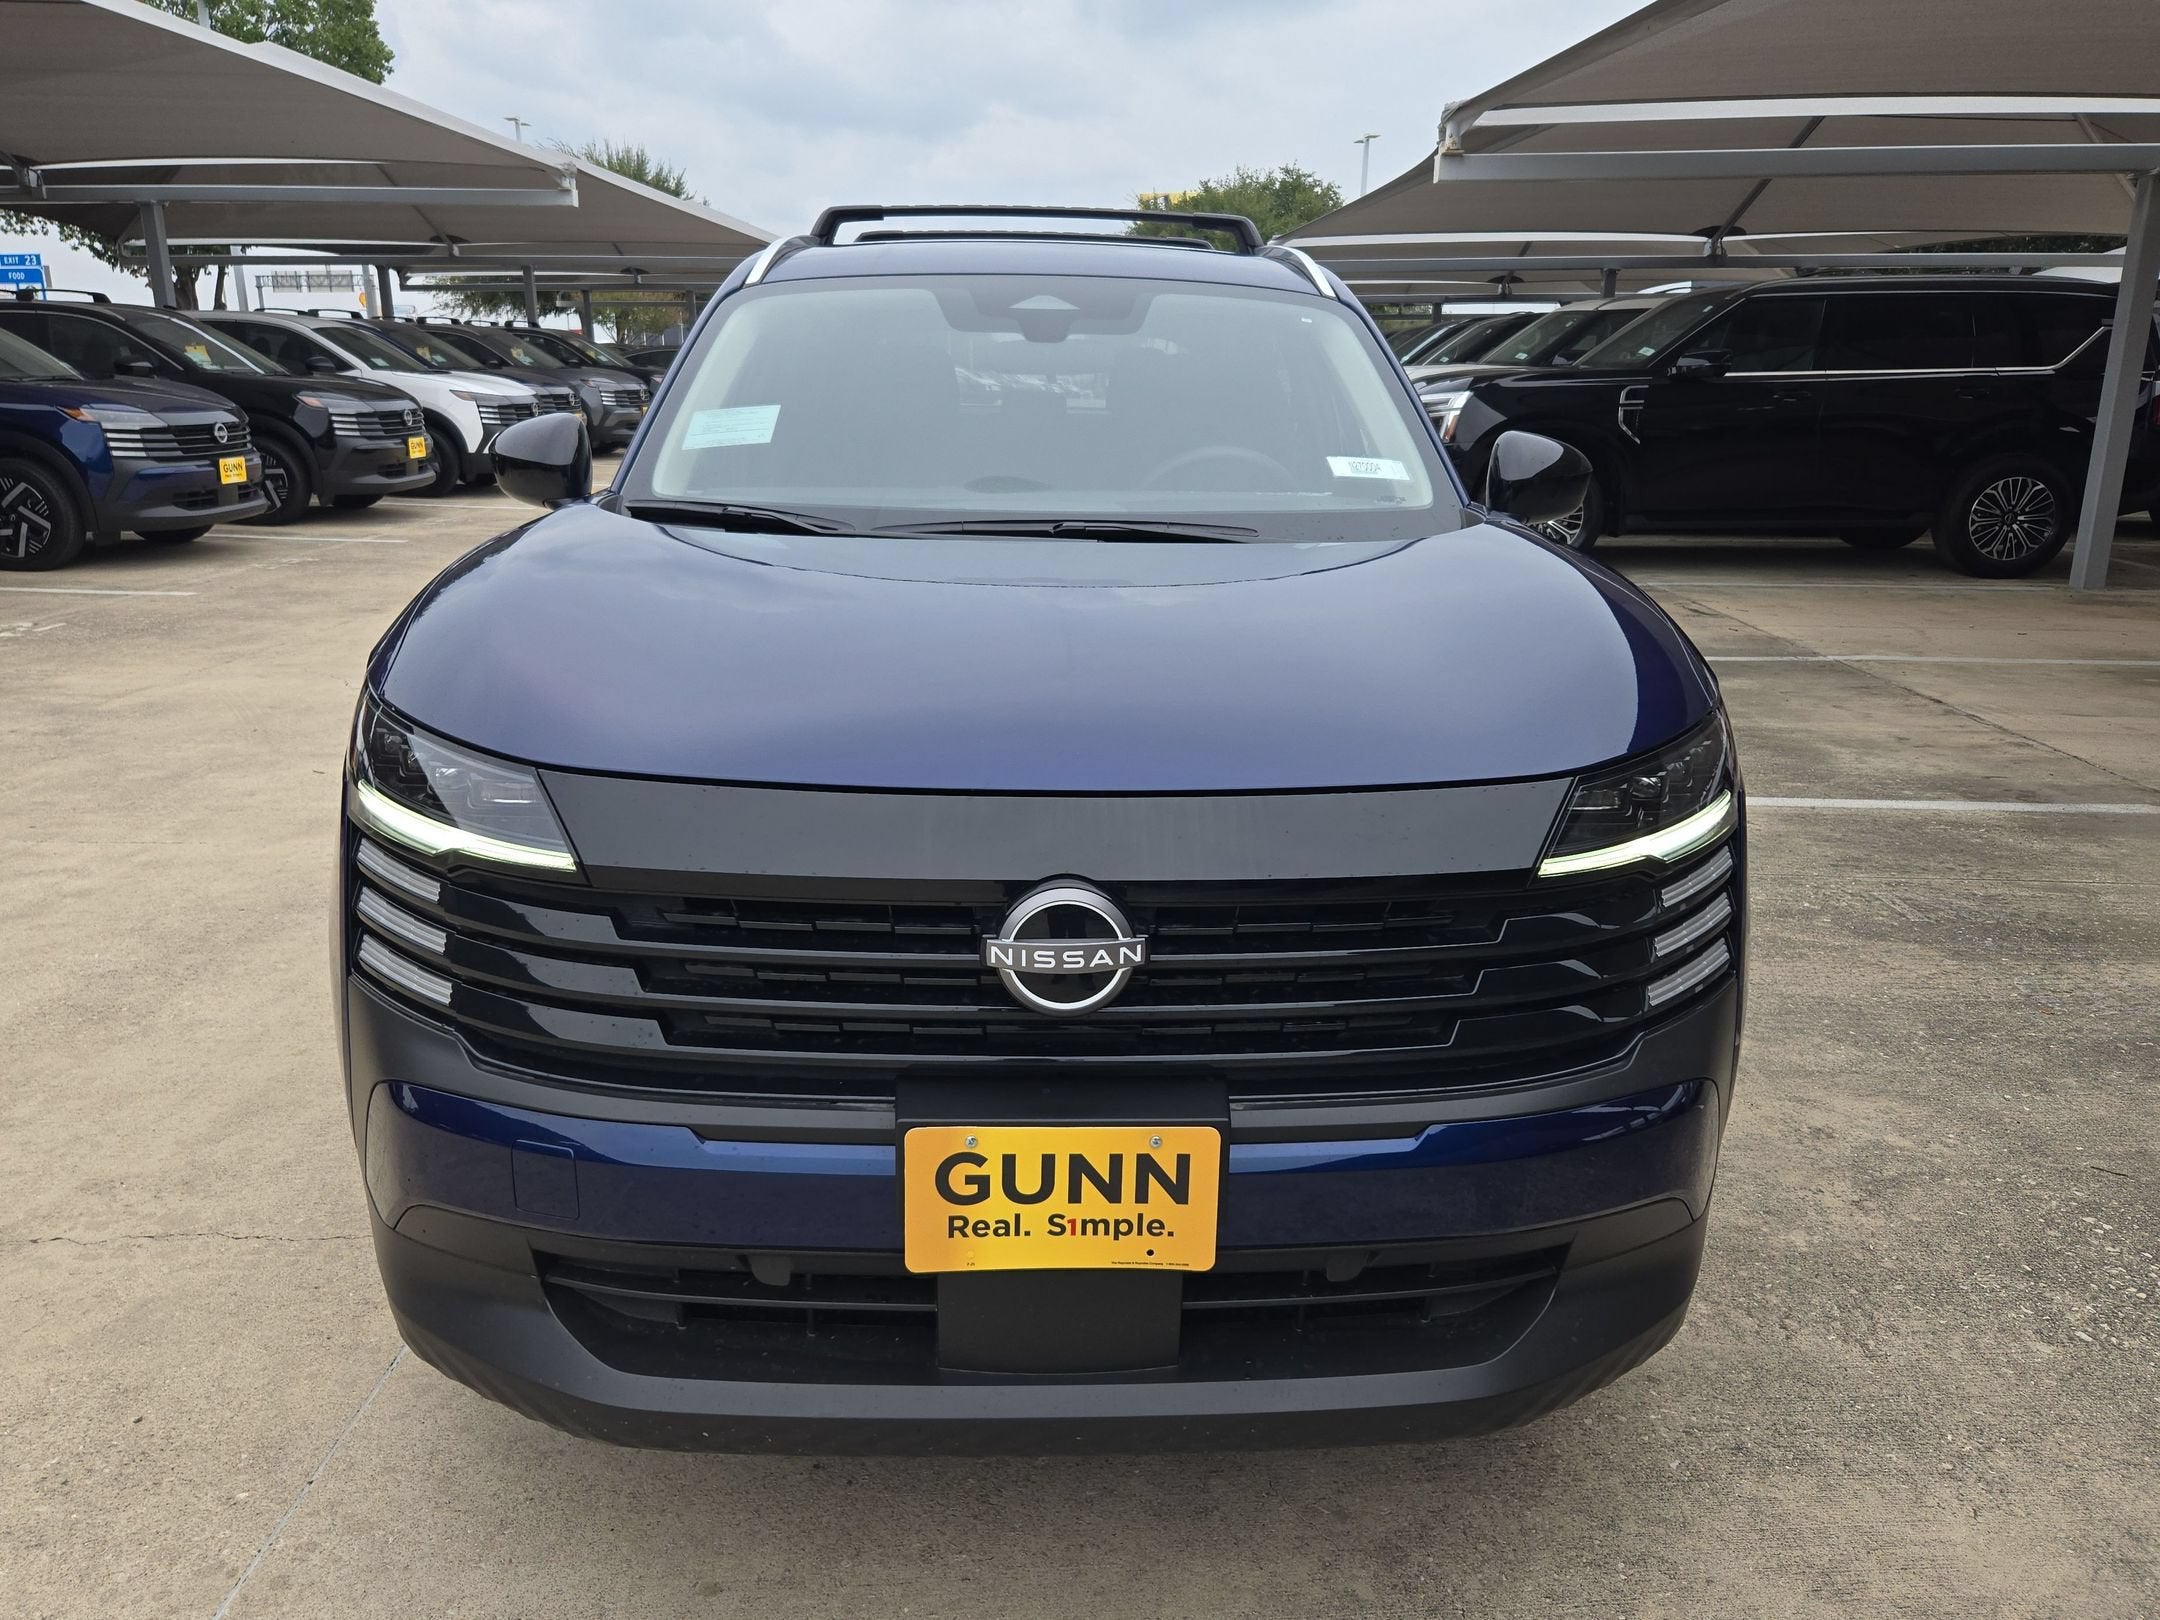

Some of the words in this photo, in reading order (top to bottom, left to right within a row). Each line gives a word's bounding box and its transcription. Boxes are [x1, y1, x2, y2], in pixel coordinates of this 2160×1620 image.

[3, 256, 19, 265] EXIT
[24, 255, 37, 266] 23
[8, 271, 25, 280] FOOD
[223, 462, 243, 473] GUNN
[990, 944, 1142, 969] NISSAN
[934, 1151, 1191, 1206] GUNN
[948, 1213, 1031, 1239] Real.
